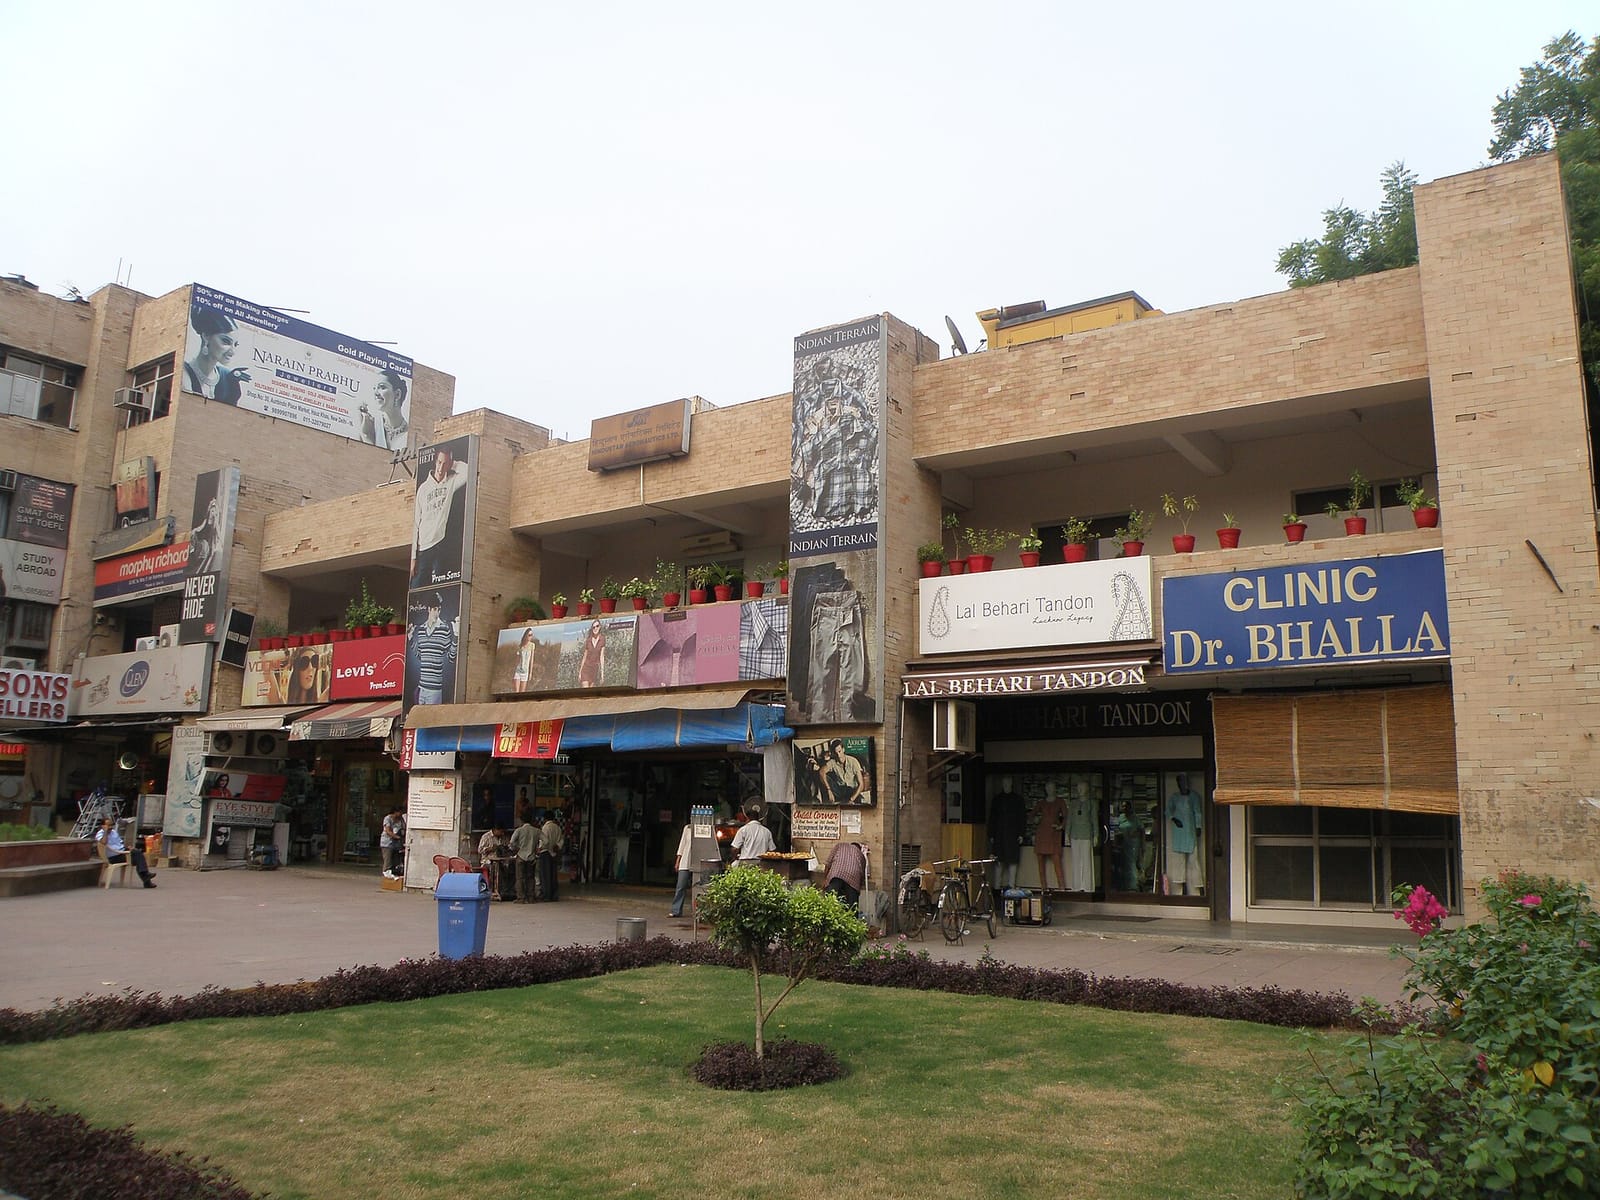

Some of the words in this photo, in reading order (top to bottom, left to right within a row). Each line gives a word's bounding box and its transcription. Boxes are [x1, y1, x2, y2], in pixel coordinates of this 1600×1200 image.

[195, 296, 211, 306] 10%
[212, 302, 224, 310] off
[224, 306, 234, 314] on
[234, 308, 245, 318] All
[245, 312, 279, 330] Jewellery
[196, 286, 213, 297] 50%
[213, 293, 225, 302] off
[225, 297, 235, 305] on
[235, 300, 261, 315] Making
[261, 309, 289, 324] Charges
[794, 334, 832, 352] INDIAN
[833, 323, 879, 342] TERRAIN
[252, 347, 306, 373] NARAIN
[308, 365, 361, 393] PRABHU
[337, 344, 357, 357] Gold
[358, 351, 388, 368] Playing
[389, 362, 412, 375] Cards
[16, 515, 34, 524] SAT
[36, 518, 65, 531] TOEFL
[17, 506, 43, 517] GMAT
[46, 511, 65, 522] GRE
[789, 537, 829, 553] INDIAN
[830, 531, 878, 547] TERRAIN
[16, 563, 57, 578] ABROAD
[22, 552, 54, 566] STUDY
[119, 555, 155, 577] morphy
[155, 545, 190, 569] richard
[185, 574, 216, 598] NEVER
[1223, 565, 1378, 613] CLINIC
[182, 597, 205, 620] HIDE
[955, 604, 976, 620] Lal
[982, 599, 1030, 617] Behari
[1035, 595, 1094, 613] Tandon
[1169, 630, 1234, 668] Dr.
[1245, 610, 1447, 664] BHALLA
[0, 671, 69, 701] SONS
[903, 679, 943, 698] LAL
[948, 675, 1034, 695] BEHARI
[1039, 664, 1147, 692] TANDON
[1099, 700, 1191, 727] TANDON
[499, 737, 523, 753] OFF
[537, 734, 552, 744] SALE
[216, 802, 237, 811] EYE
[241, 803, 273, 814] STYLE
[813, 810, 839, 820] Corner
